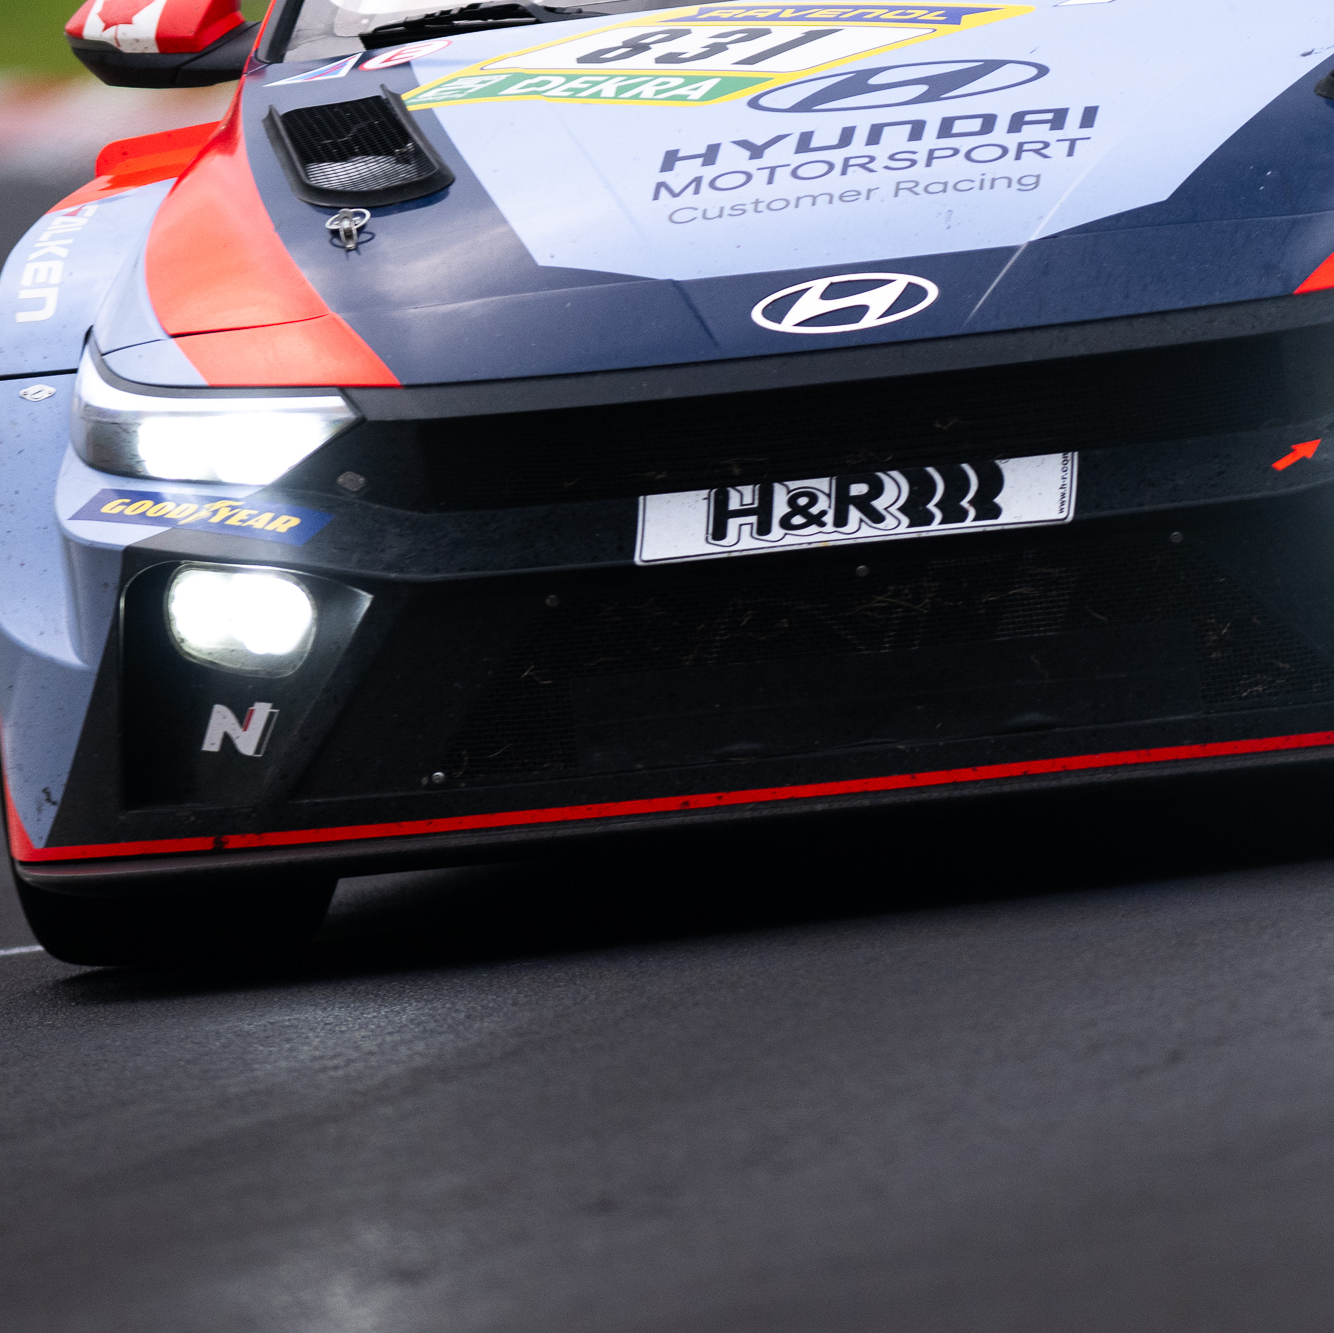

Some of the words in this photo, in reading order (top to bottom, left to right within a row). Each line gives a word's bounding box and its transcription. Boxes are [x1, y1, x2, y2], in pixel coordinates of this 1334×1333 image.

[699, 7, 951, 22] RAVENOL
[576, 28, 846, 66] 831
[498, 75, 723, 102] DEKRA
[659, 105, 1100, 173] HYUNDAI
[652, 137, 1091, 201] MOTORSPORT
[667, 182, 880, 225] Customer
[893, 170, 1043, 197] Racing
[15, 203, 99, 323] FALKEN
[100, 498, 302, 534] GOODYEAR
[709, 473, 888, 542] H&R
